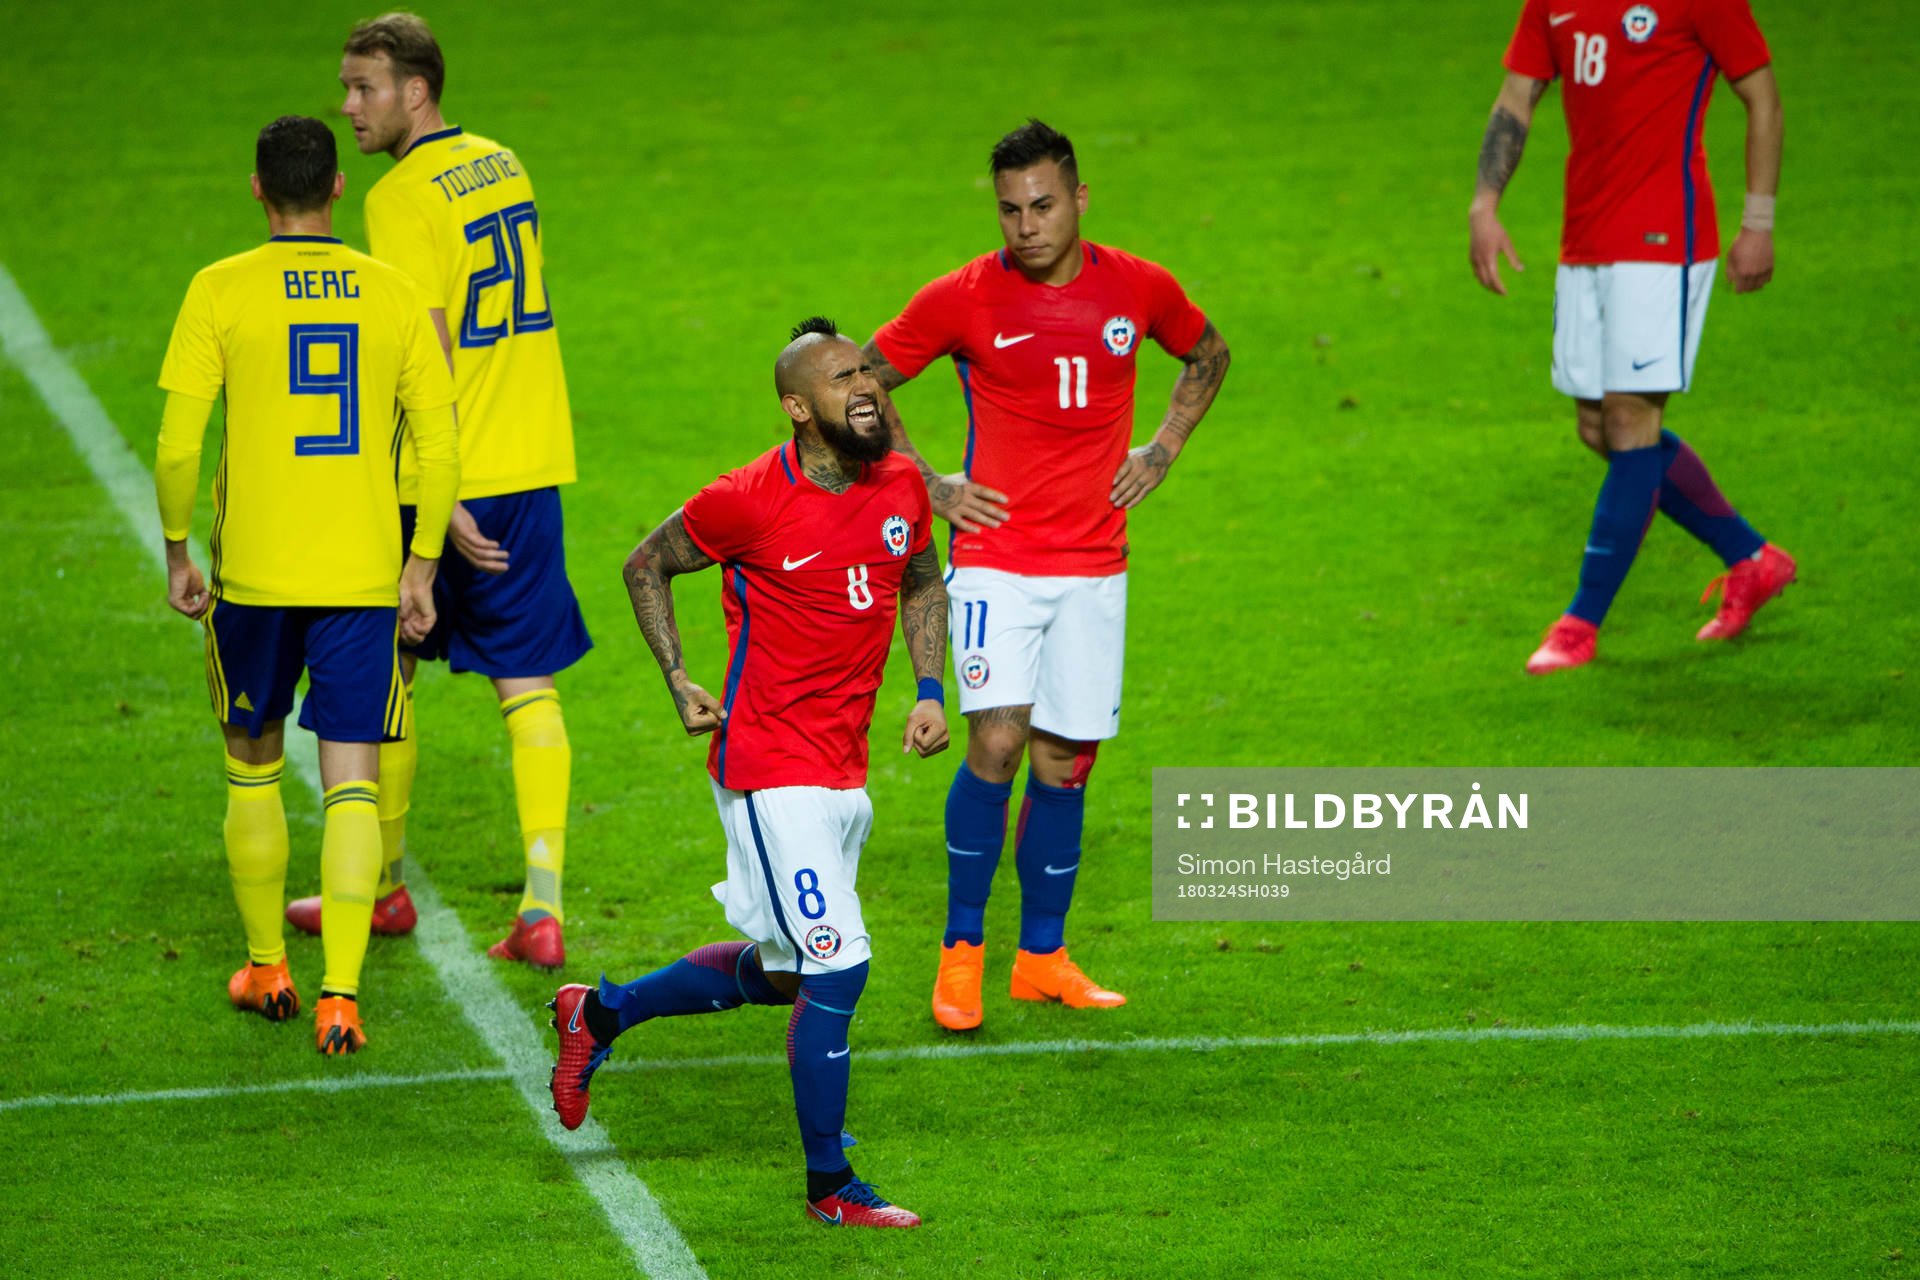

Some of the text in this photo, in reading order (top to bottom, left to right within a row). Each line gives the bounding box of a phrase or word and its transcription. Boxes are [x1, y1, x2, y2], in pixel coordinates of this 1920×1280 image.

[1573, 31, 1608, 86] 18
[283, 270, 360, 299] BERG
[459, 201, 554, 348] 20
[289, 323, 359, 456] 9
[1054, 357, 1088, 409] 11
[847, 563, 873, 610] 8
[964, 600, 988, 650] 11
[794, 868, 827, 920] 8
